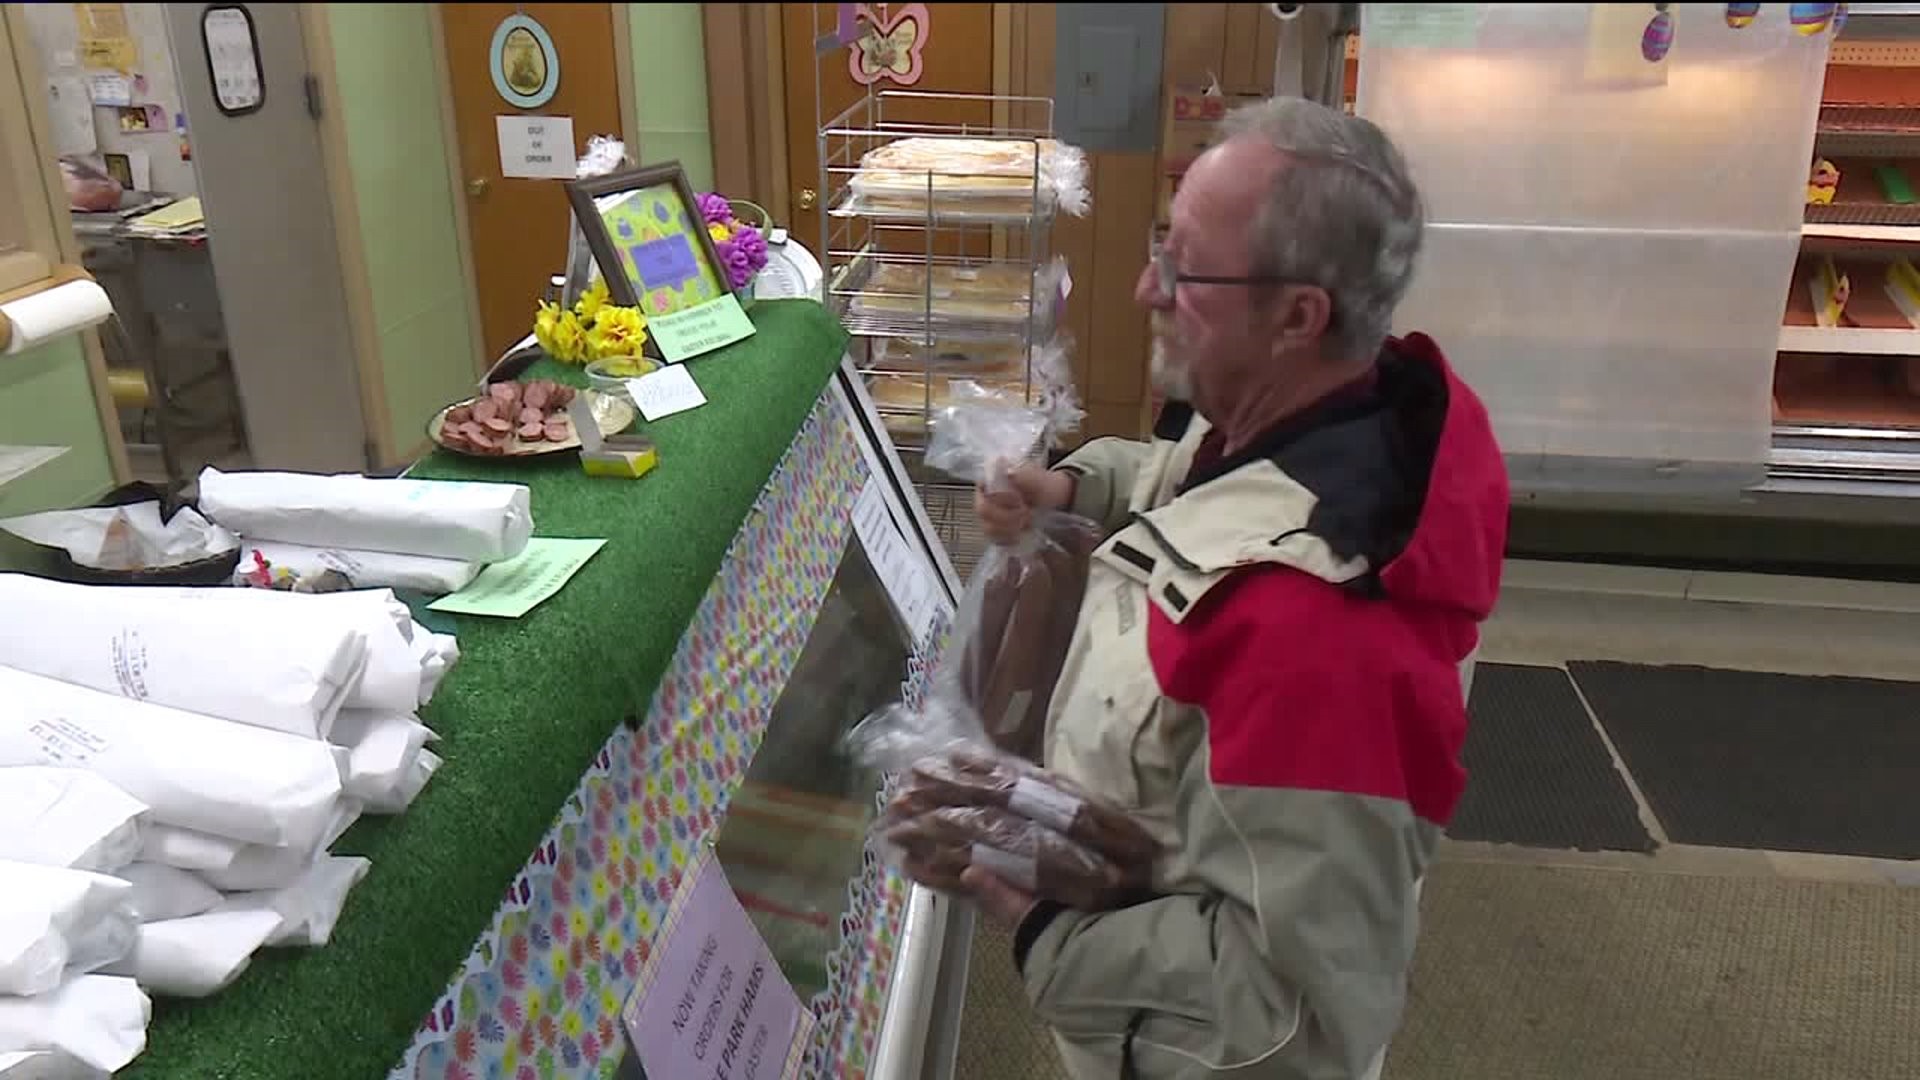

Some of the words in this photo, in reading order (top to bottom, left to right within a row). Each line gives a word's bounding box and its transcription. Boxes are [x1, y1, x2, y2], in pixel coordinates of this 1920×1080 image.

[672, 992, 698, 1035] NOW
[691, 933, 719, 988] TAKING
[693, 996, 723, 1061] ORDERS
[717, 963, 735, 998] FOR
[721, 1012, 746, 1067] PARK
[740, 960, 765, 1019] HAMS
